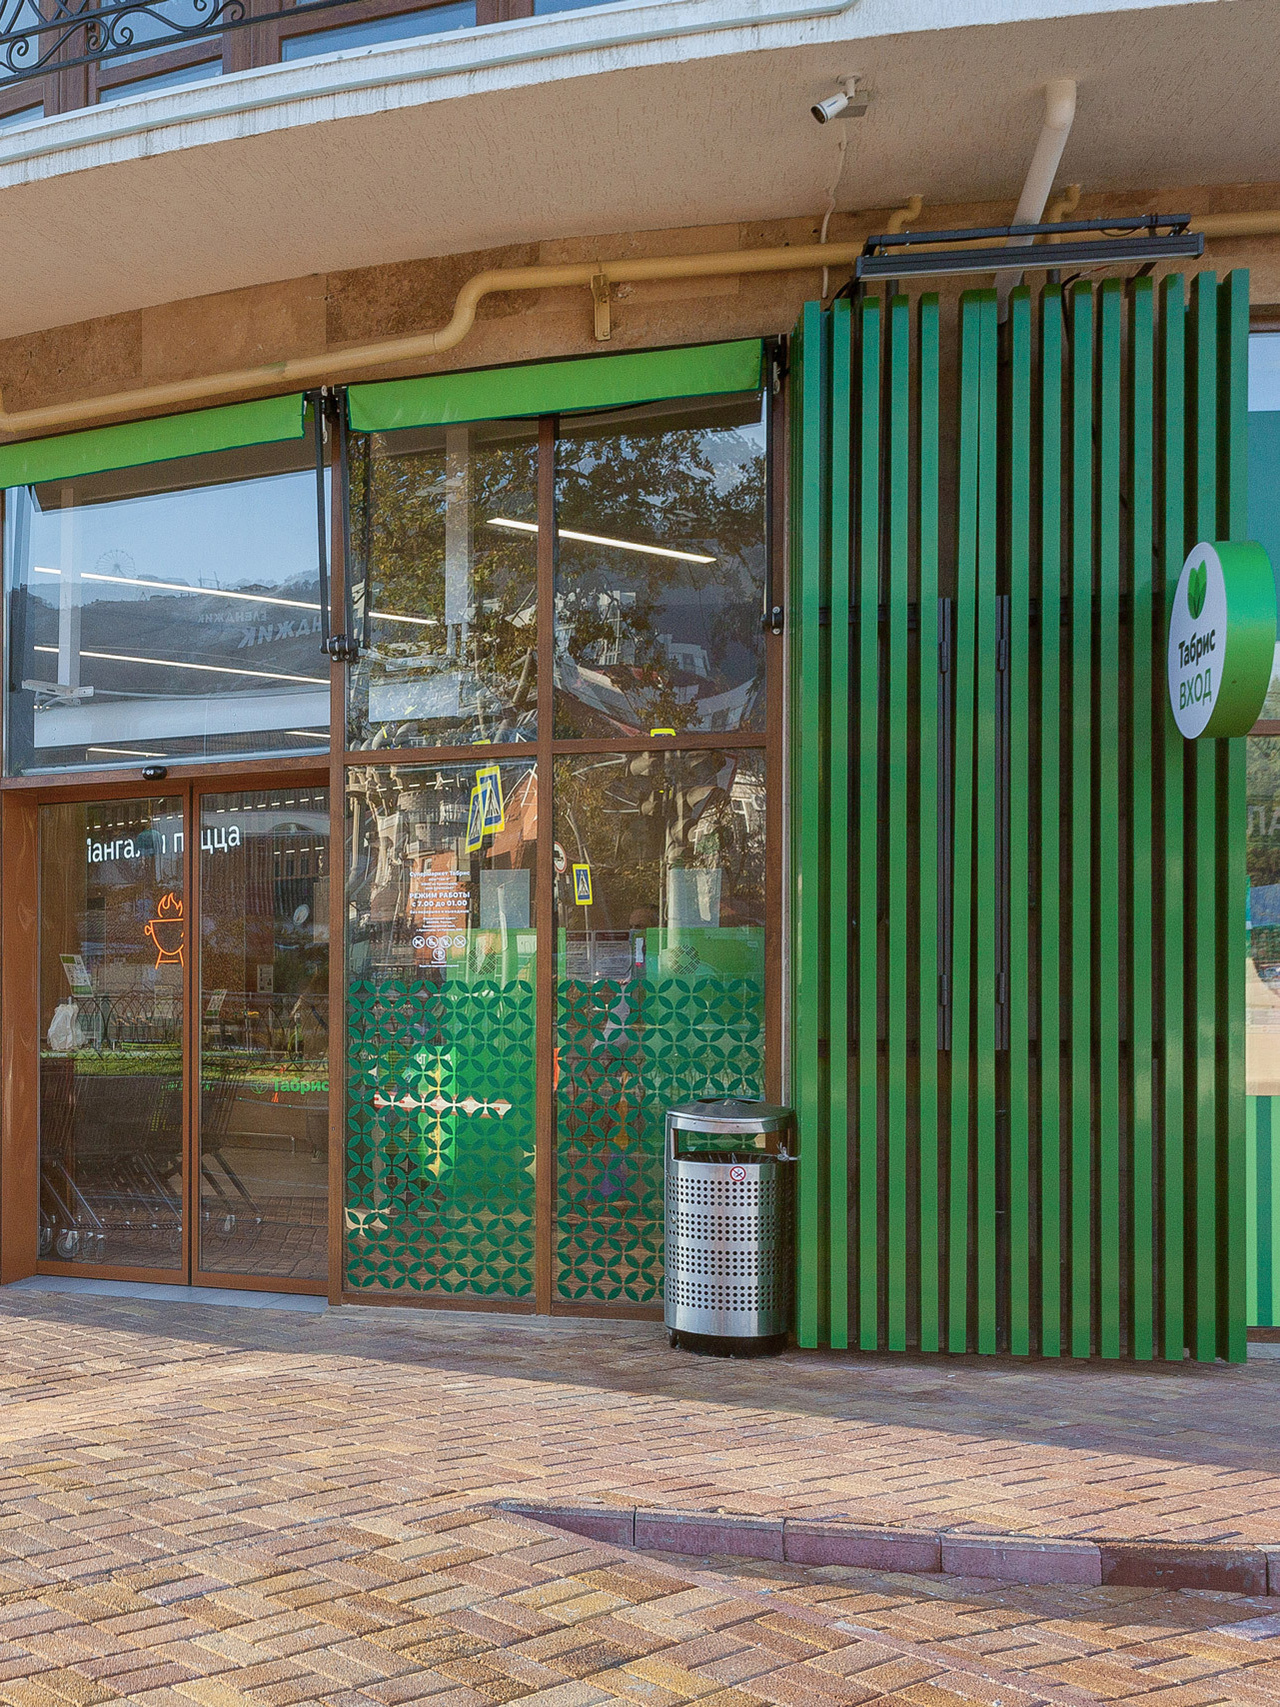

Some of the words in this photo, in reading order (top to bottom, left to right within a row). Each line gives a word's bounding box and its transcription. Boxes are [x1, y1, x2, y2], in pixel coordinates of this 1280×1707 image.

[1178, 628, 1216, 668] Табрис
[1179, 667, 1212, 709] ВХОД
[173, 825, 241, 855] пцца
[271, 1077, 329, 1095] Табрис
